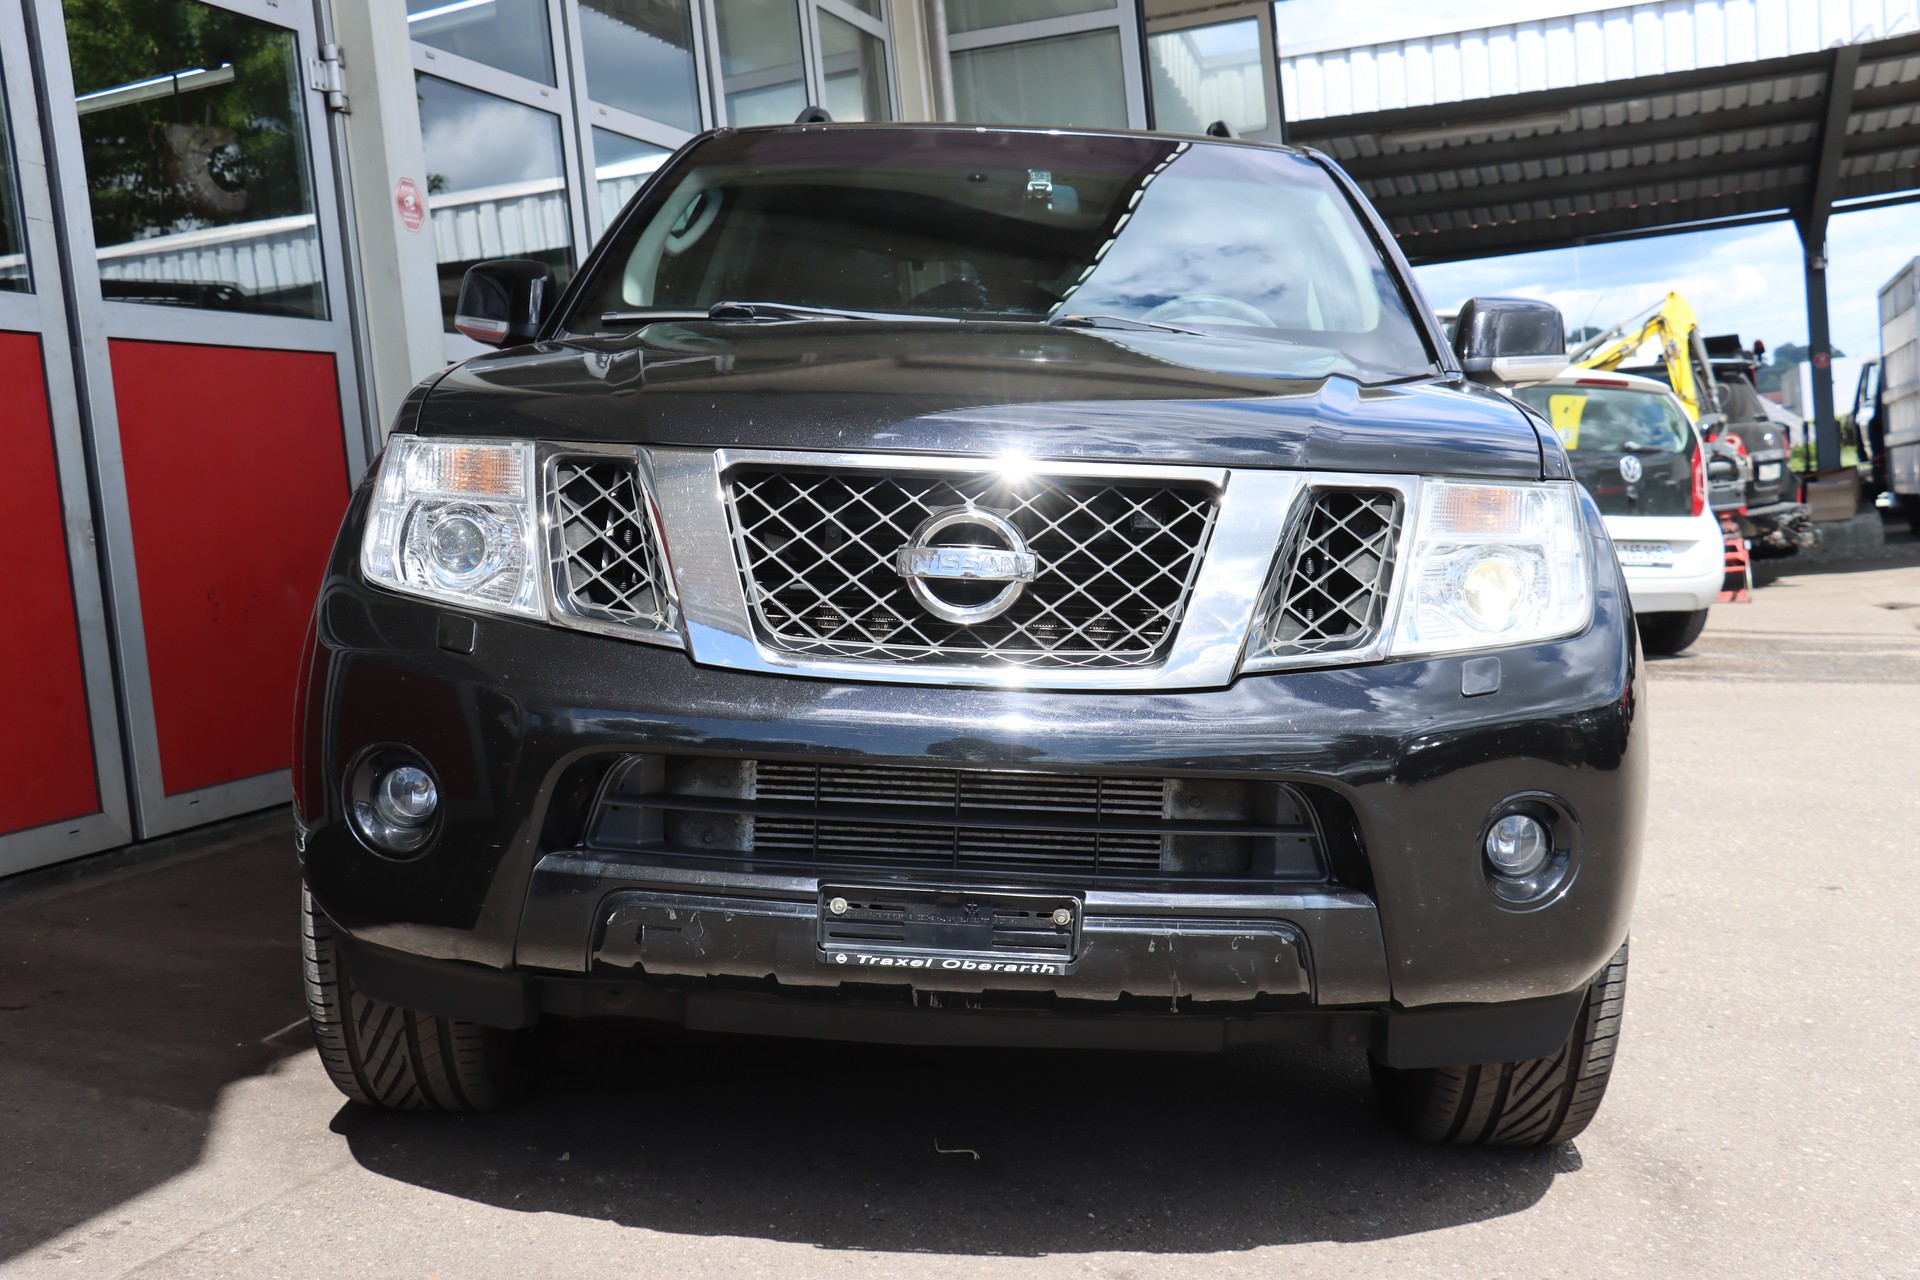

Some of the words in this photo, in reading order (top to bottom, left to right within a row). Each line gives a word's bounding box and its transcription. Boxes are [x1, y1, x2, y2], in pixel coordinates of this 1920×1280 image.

[911, 553, 1021, 574] NISSAN
[856, 954, 933, 968] Traxel
[941, 959, 1055, 974] Oberarth
